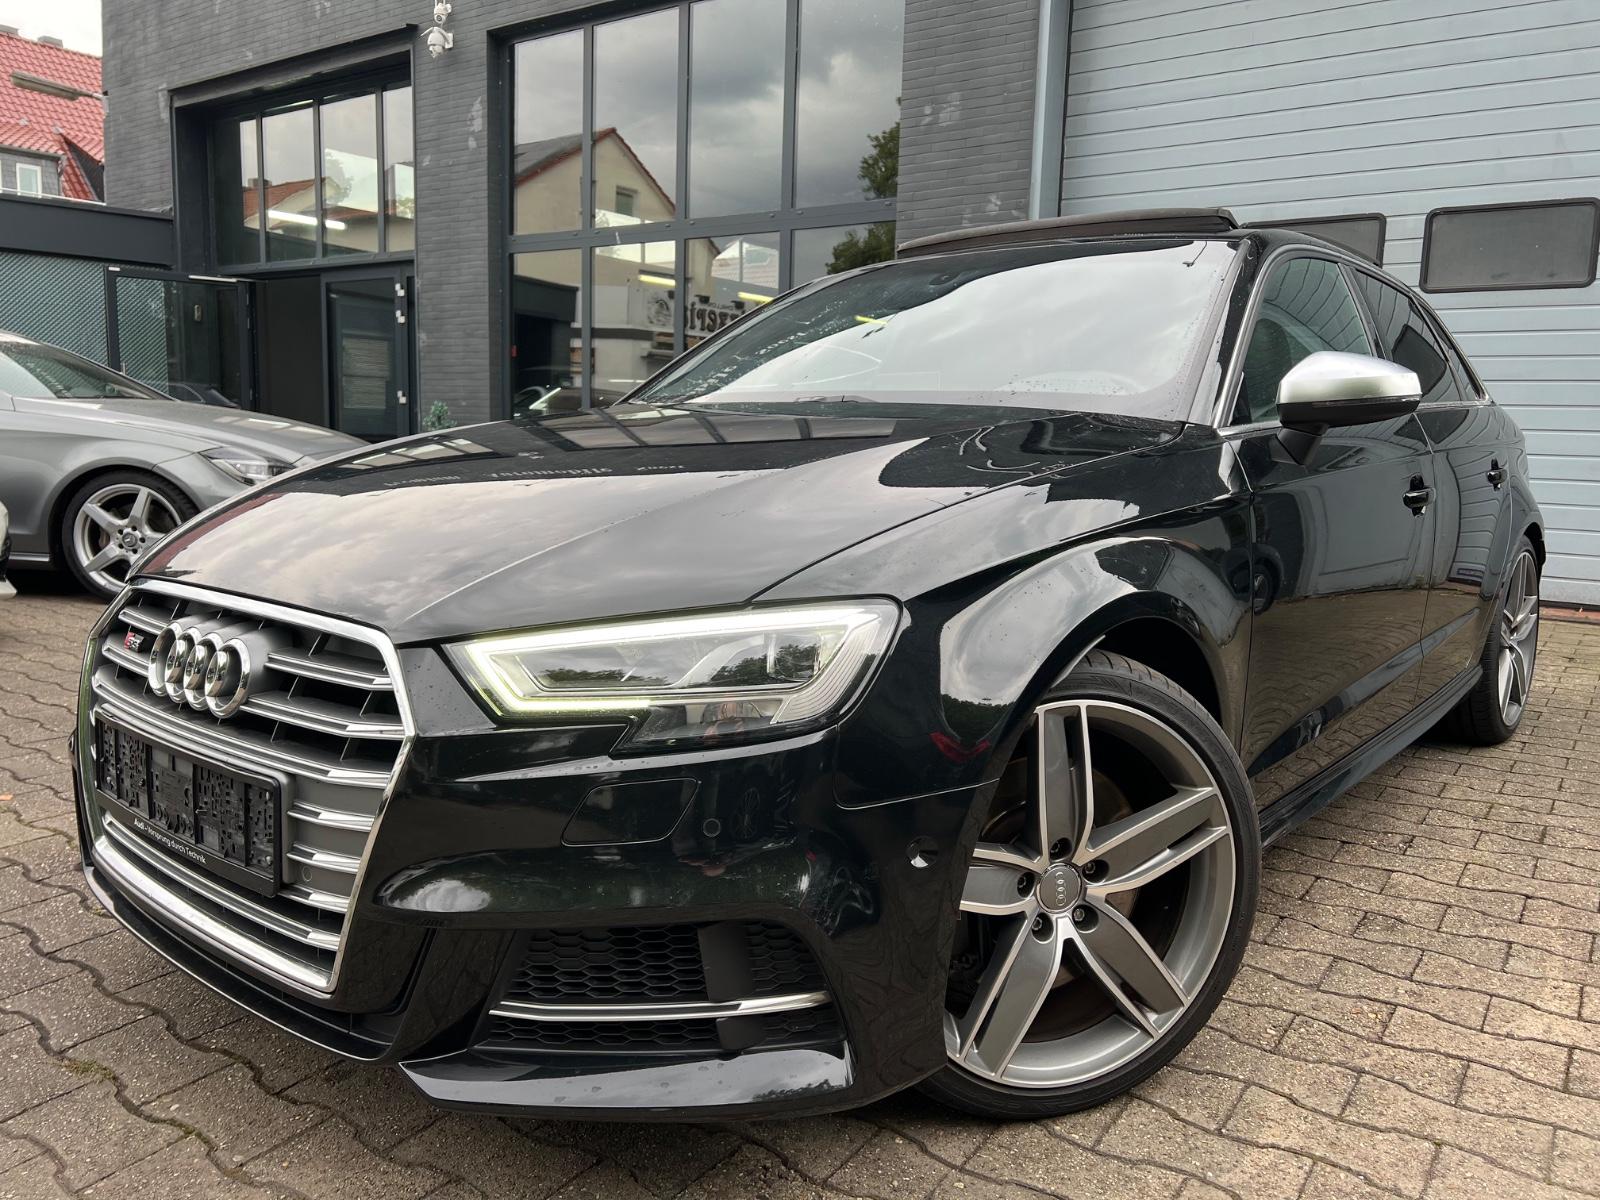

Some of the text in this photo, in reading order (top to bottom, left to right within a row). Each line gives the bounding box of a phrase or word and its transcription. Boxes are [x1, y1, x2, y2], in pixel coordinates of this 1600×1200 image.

[134, 818, 145, 830] Audi
[147, 825, 171, 847] Vorsprung
[171, 840, 186, 854] durch
[185, 847, 207, 864] Technik
